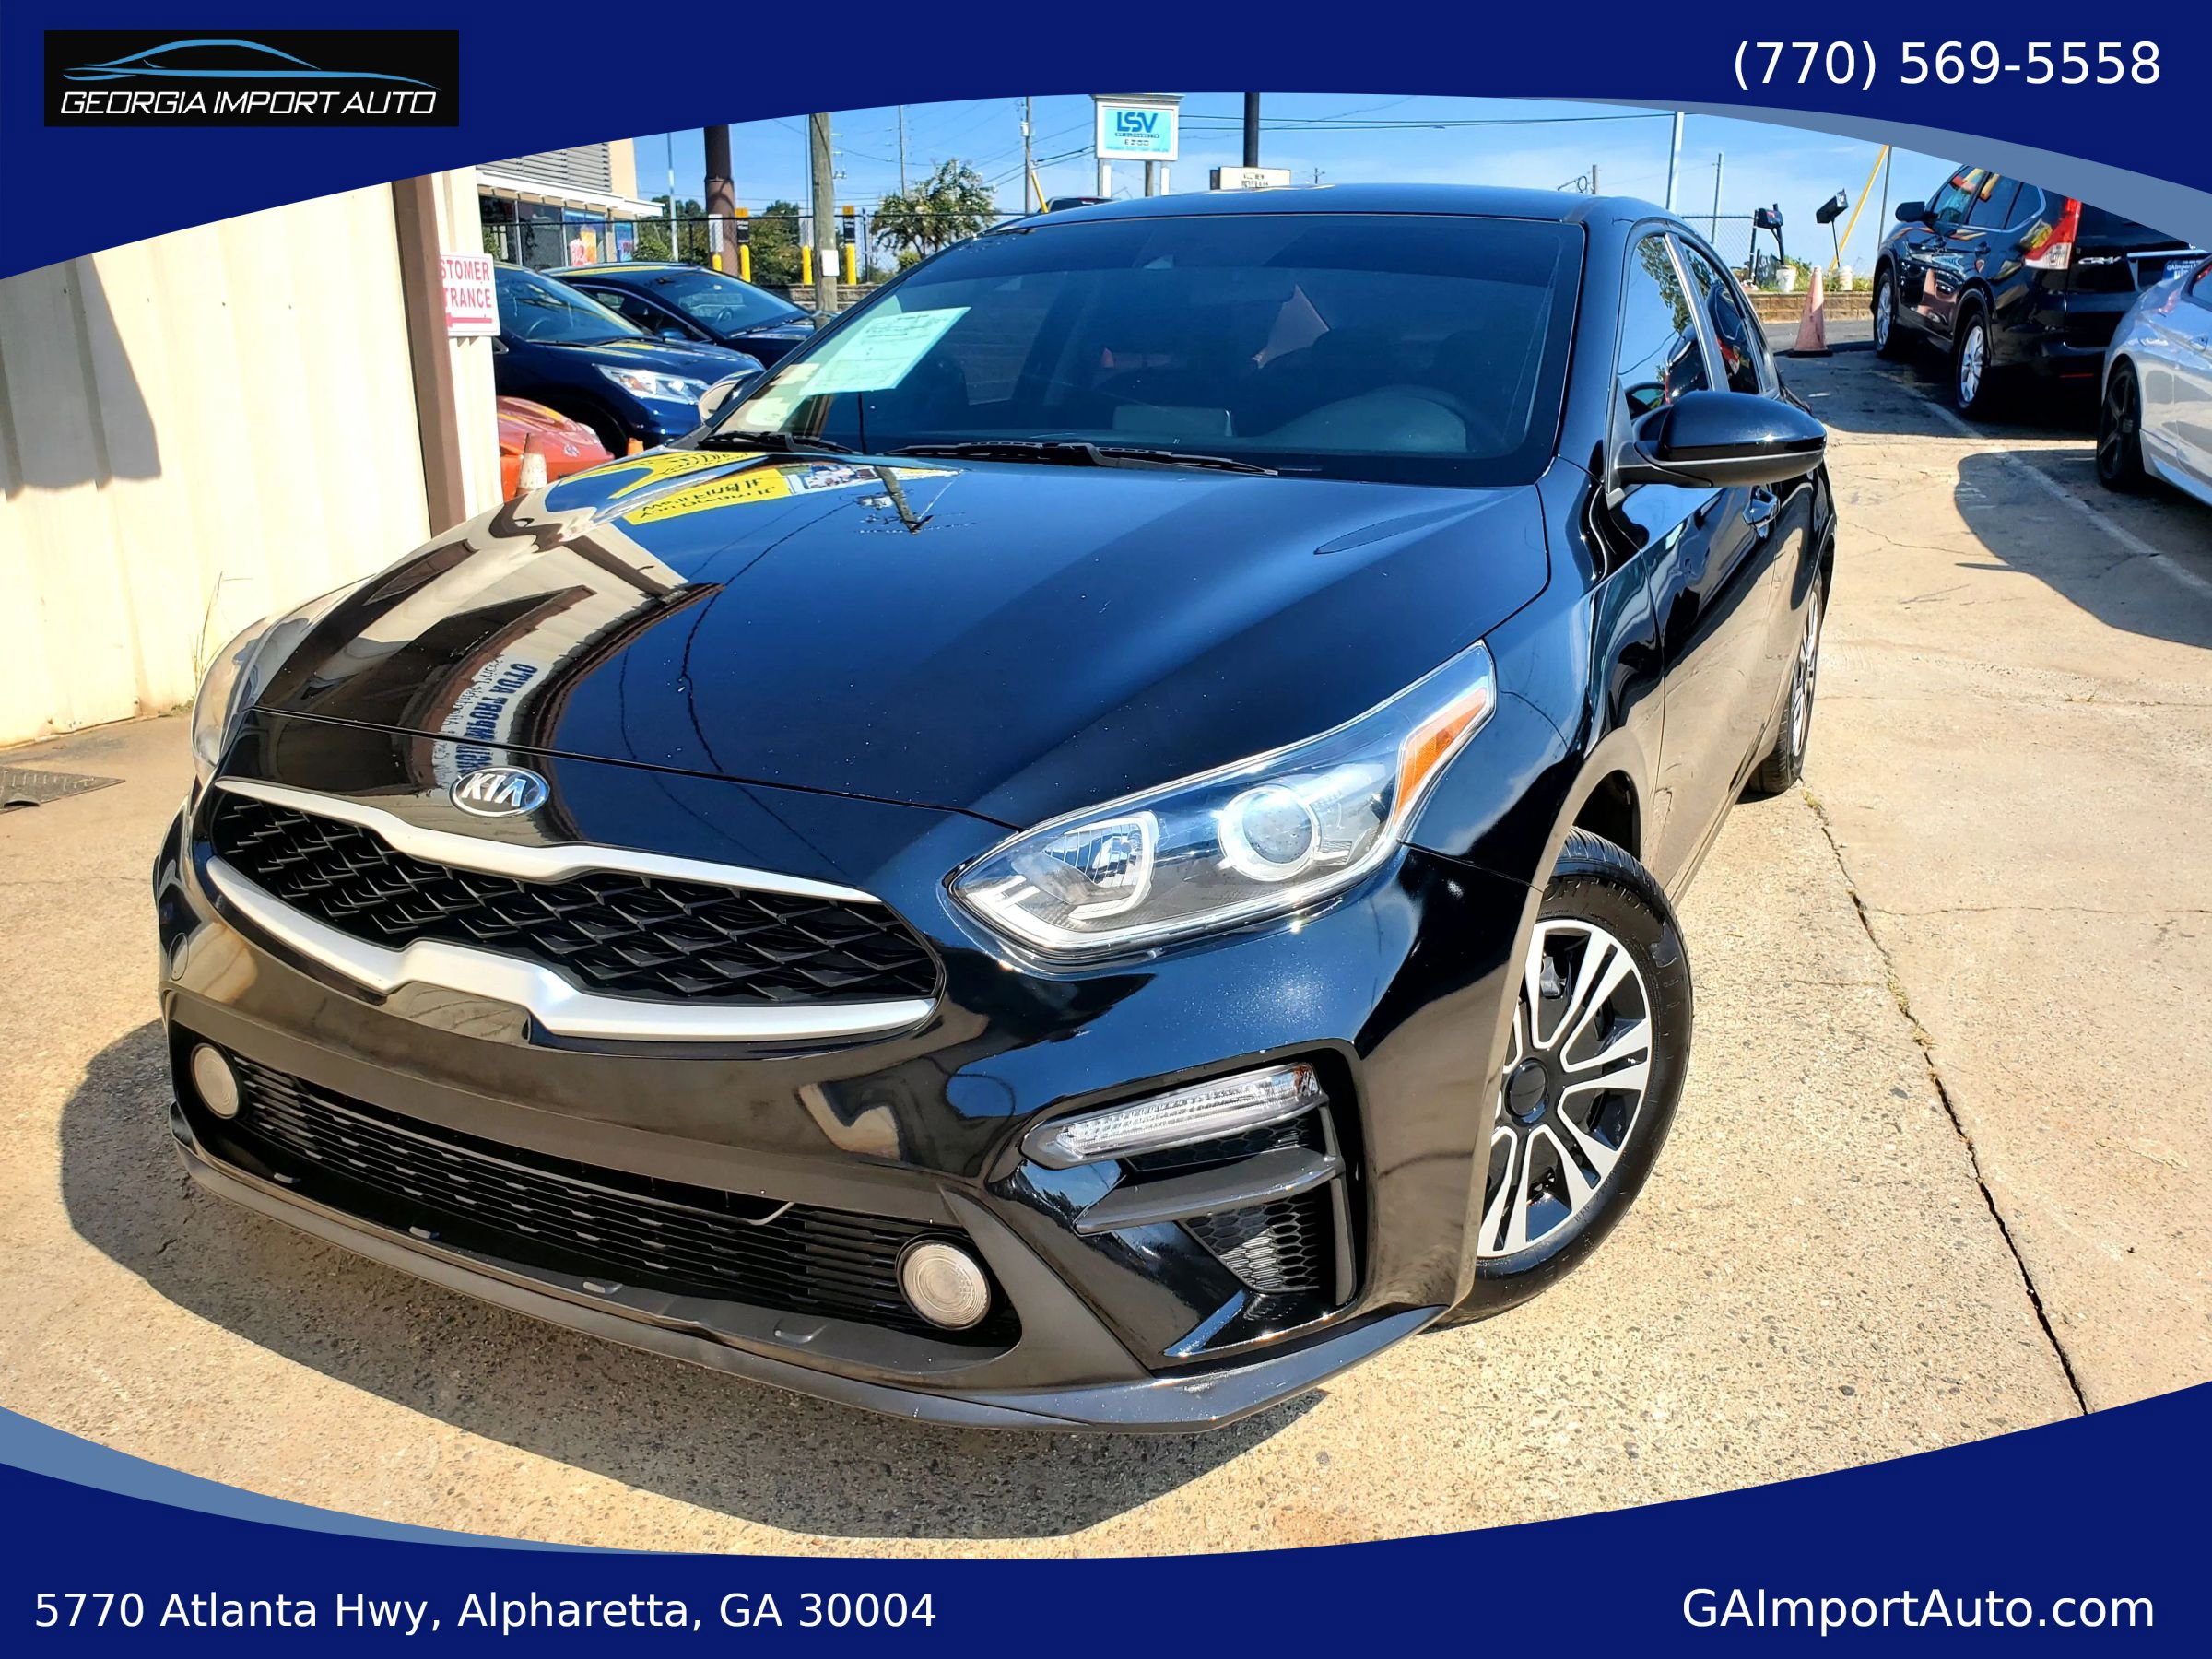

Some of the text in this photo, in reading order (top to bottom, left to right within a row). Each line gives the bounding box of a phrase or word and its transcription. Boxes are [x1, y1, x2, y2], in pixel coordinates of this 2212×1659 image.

[1116, 112, 1159, 133] LSV
[441, 259, 490, 281] STOMER
[442, 287, 492, 309] TRANCE
[461, 772, 527, 807] KIA
